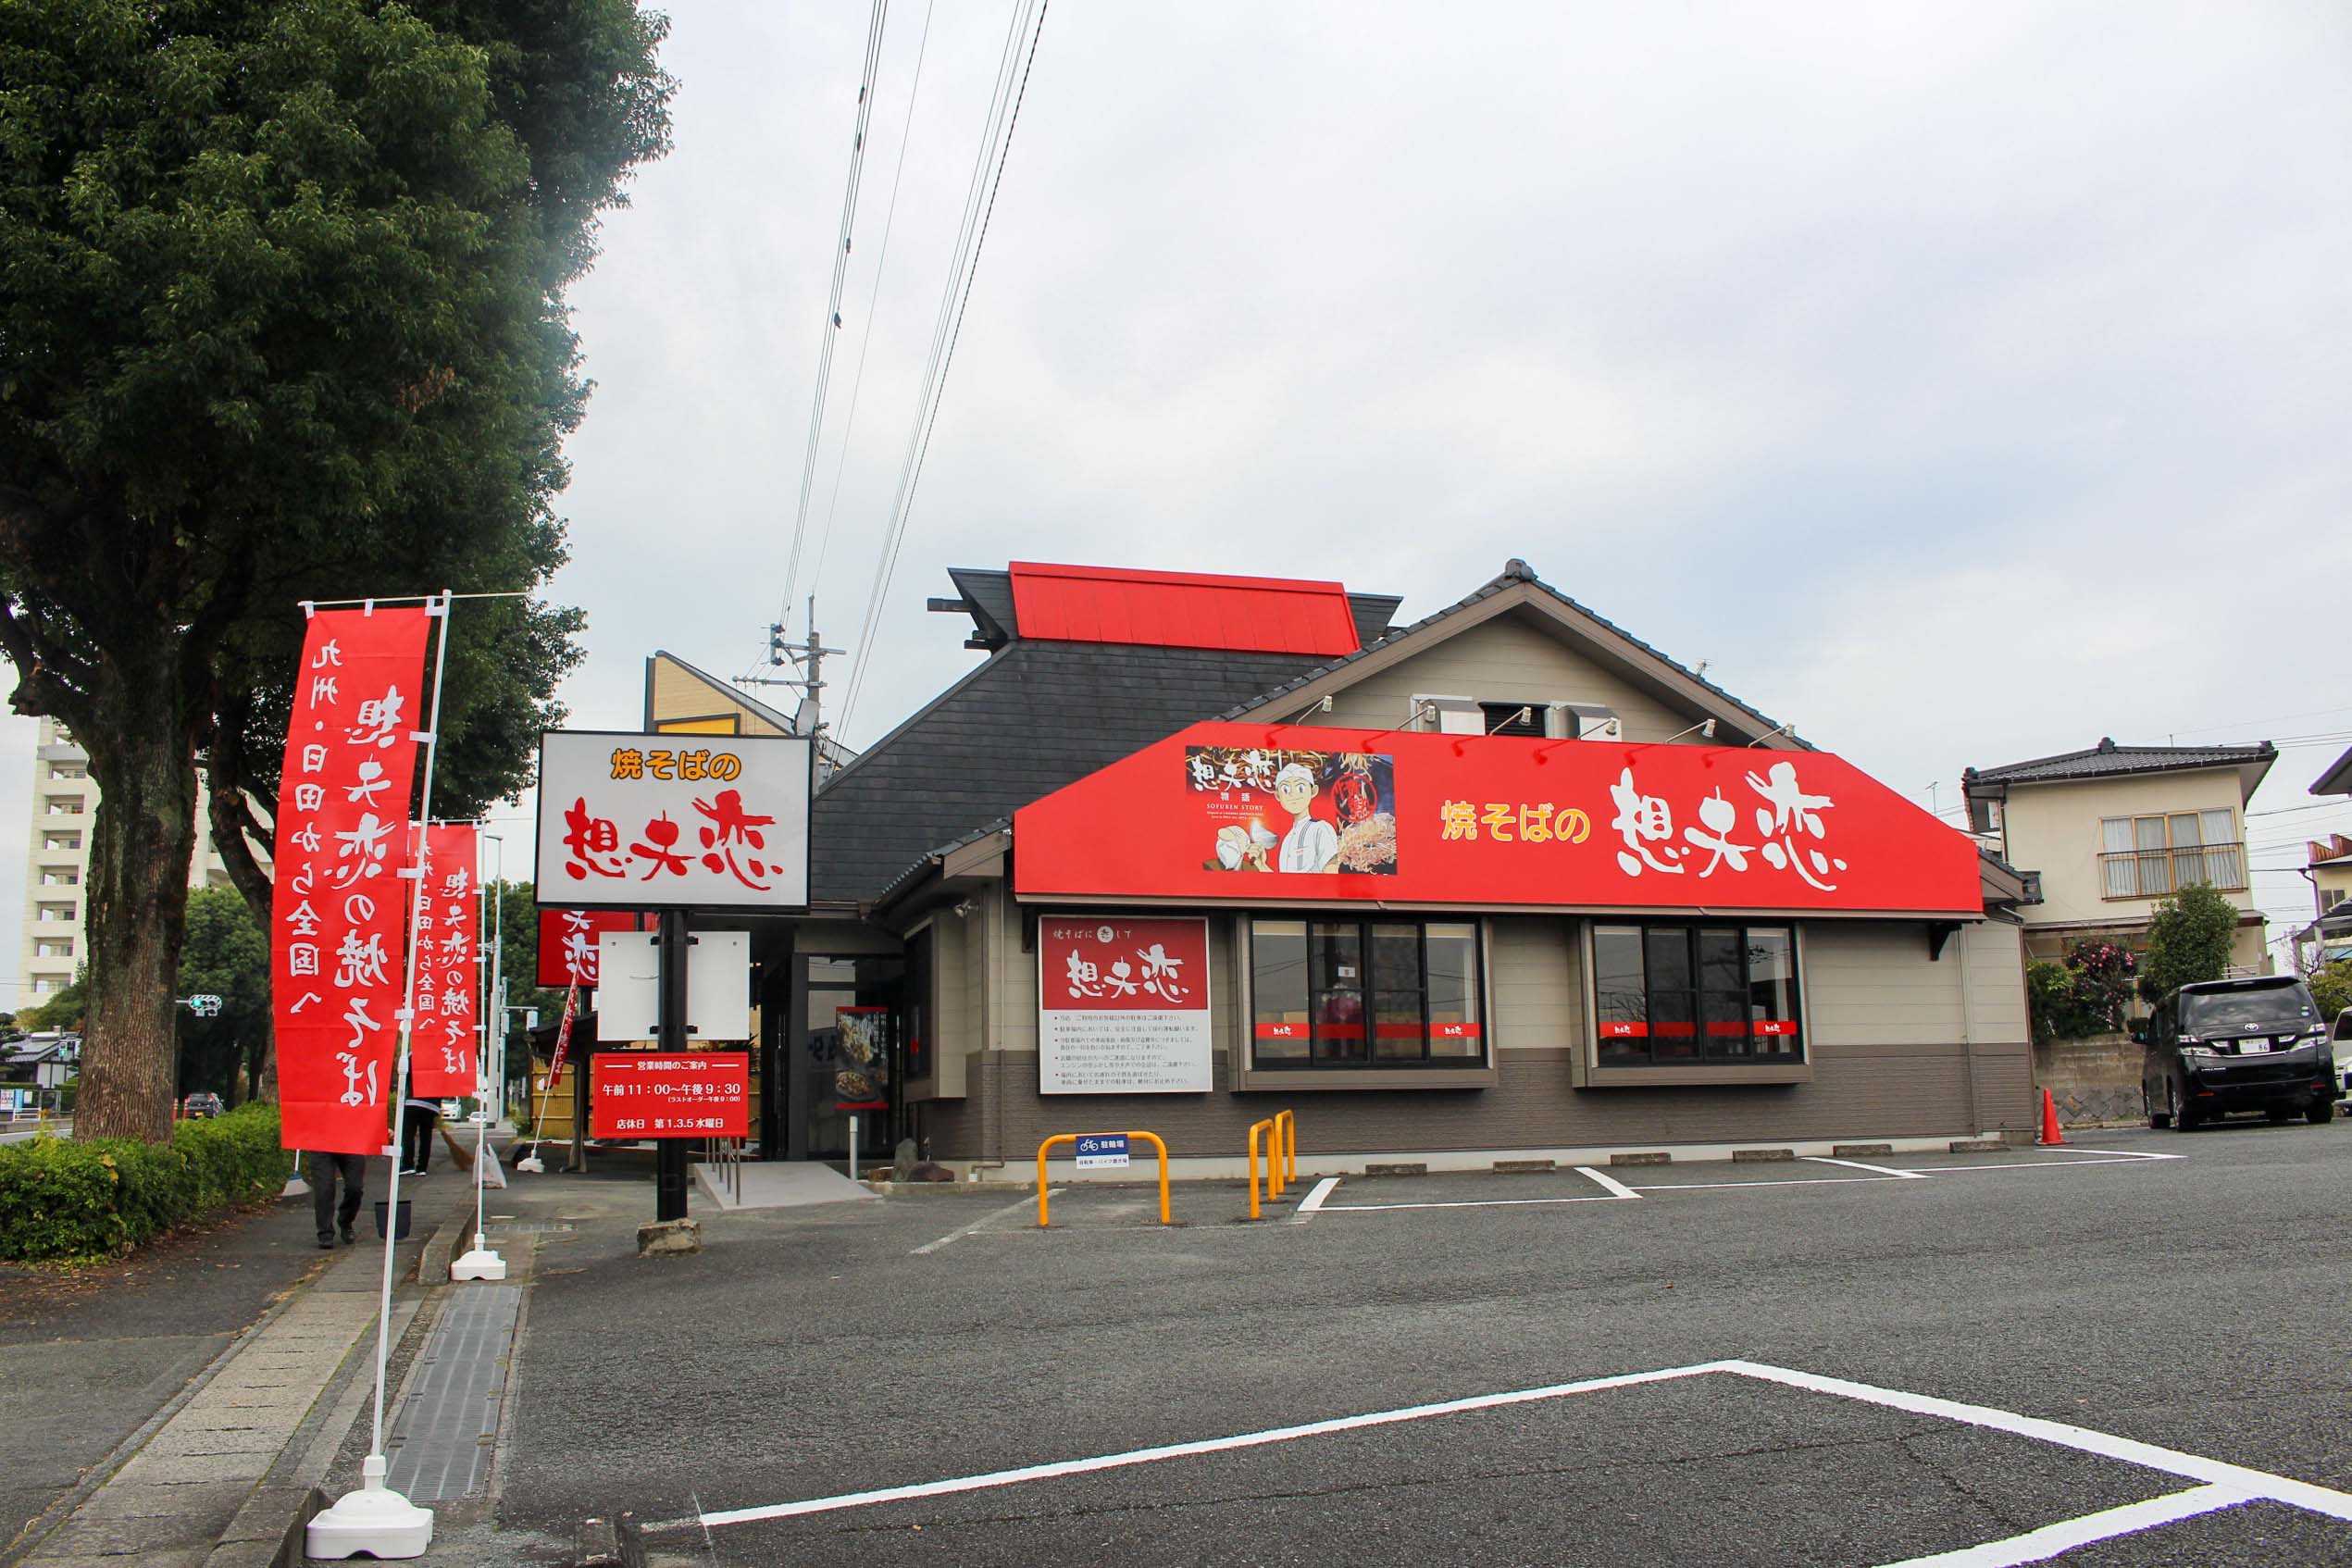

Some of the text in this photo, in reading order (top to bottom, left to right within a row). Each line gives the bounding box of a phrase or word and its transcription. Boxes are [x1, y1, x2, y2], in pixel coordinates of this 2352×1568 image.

[611, 748, 741, 781] 焼そばの
[564, 790, 783, 890] 想夫恋
[1440, 761, 1848, 891] 焼そばの 想夫恋
[1066, 944, 1189, 1002] 想夫恋
[637, 1061, 707, 1071] 営業時間のご案内
[616, 1119, 645, 1129] 店休日
